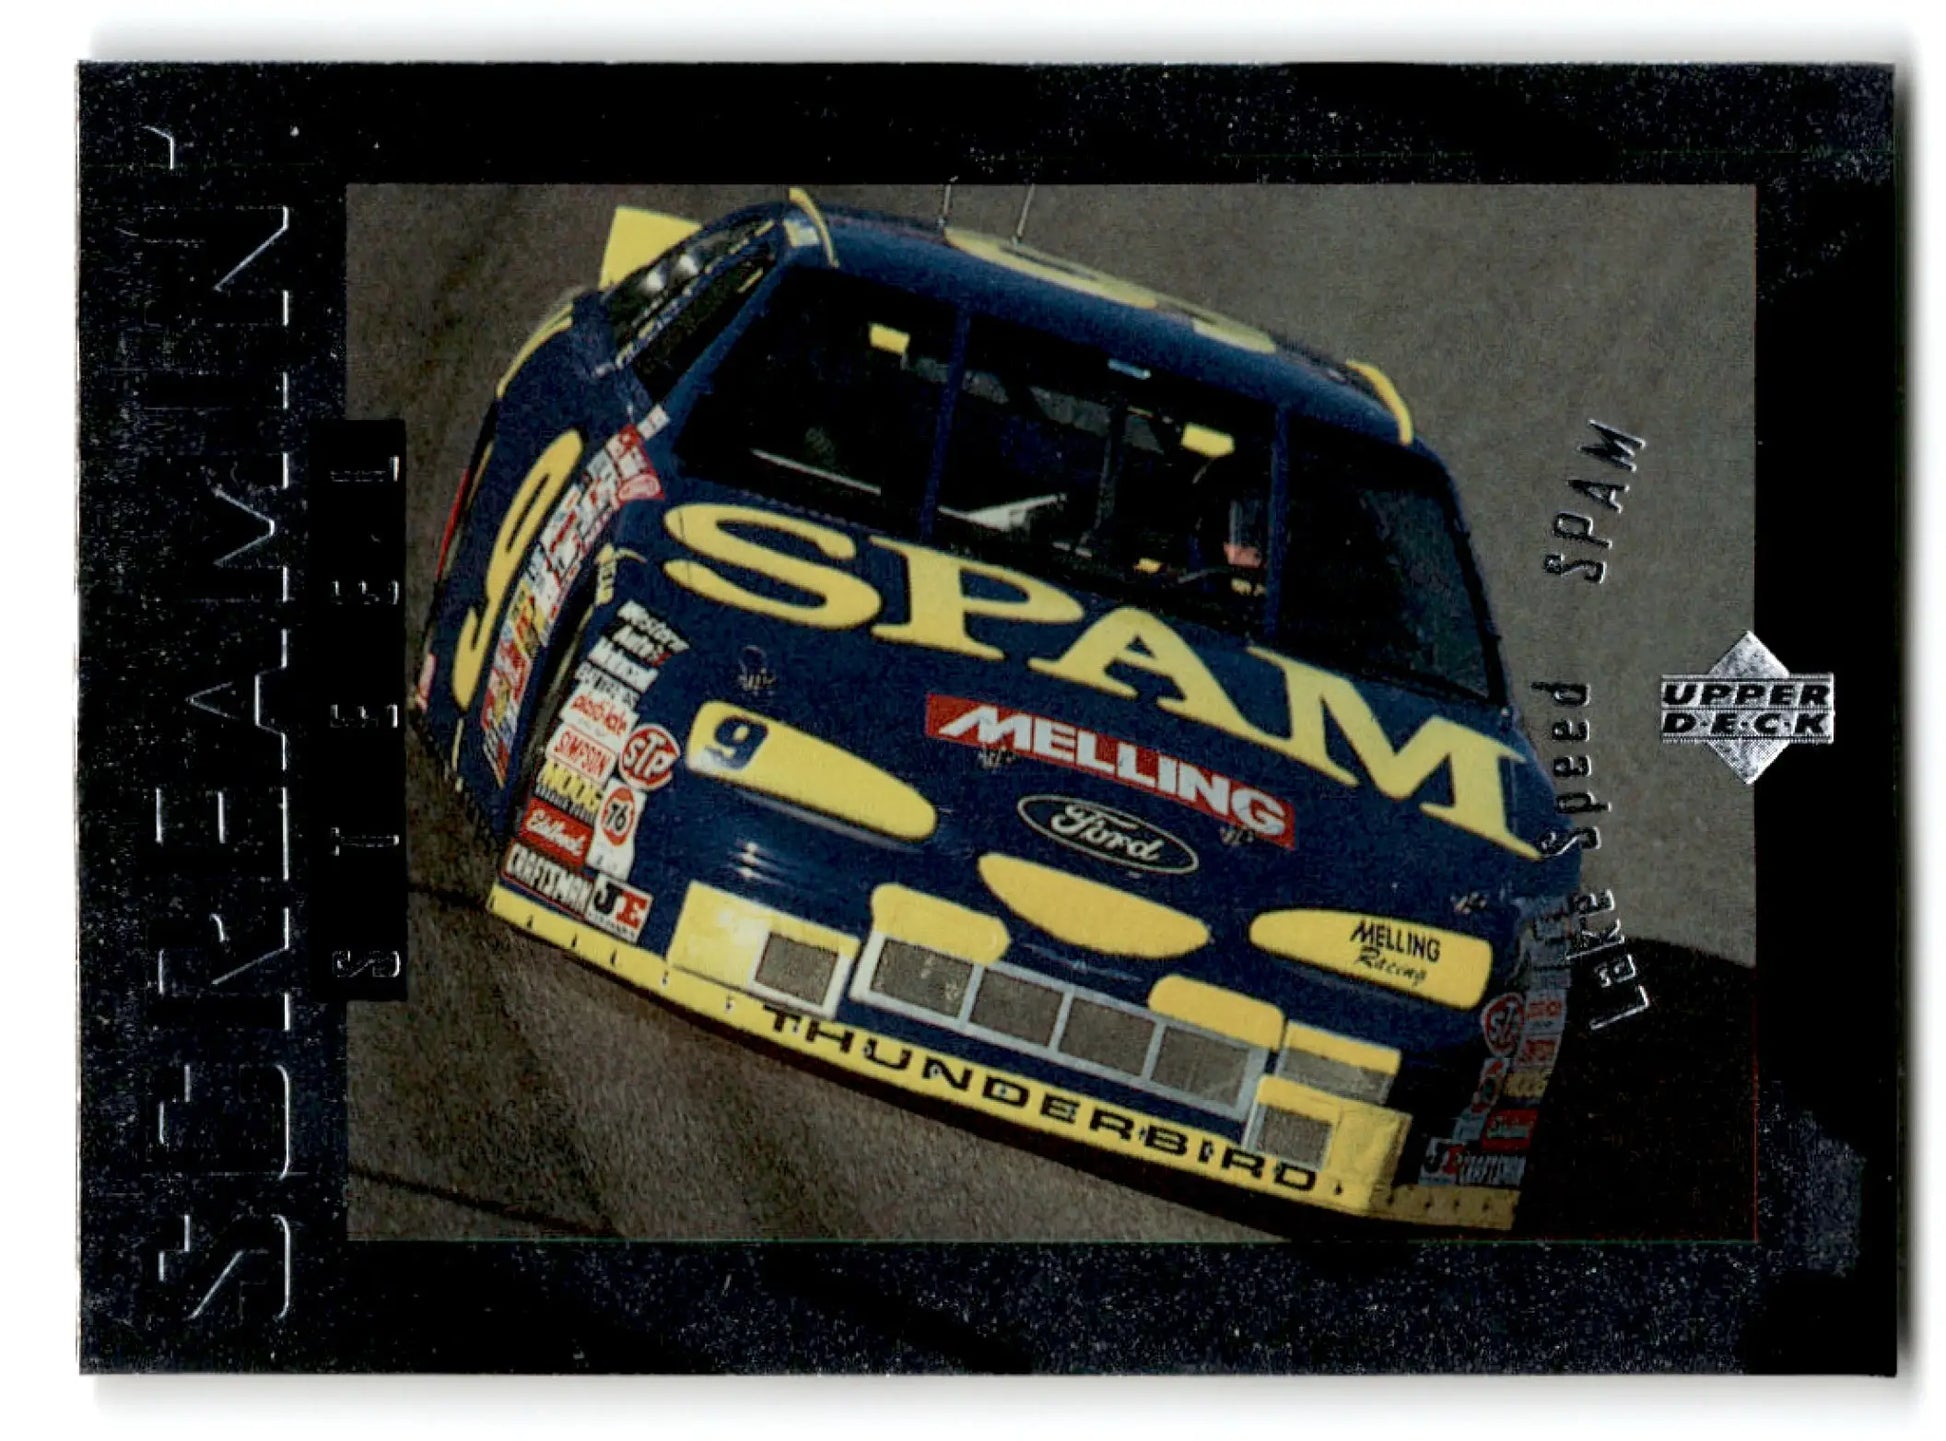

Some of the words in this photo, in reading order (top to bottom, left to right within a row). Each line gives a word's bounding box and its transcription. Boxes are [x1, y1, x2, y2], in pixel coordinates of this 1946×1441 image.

[1543, 419, 1646, 584] SPAM
[663, 503, 1544, 859] SPAM
[1662, 684, 1830, 705] UPPER
[328, 453, 402, 981] STEEL
[703, 717, 769, 771] 9
[554, 731, 610, 778] SIMPSON
[623, 731, 678, 779] STP
[938, 705, 1286, 836] MELLING
[1531, 681, 1612, 860] Speed
[605, 803, 629, 832] 76
[1050, 803, 1165, 863] Ford
[506, 842, 593, 915] CRAFTSMAN
[1349, 919, 1441, 962] MELLING
[1353, 944, 1427, 987] Racing
[1564, 888, 1651, 1030] Lake
[761, 1003, 1317, 1191] THUNDERBIRD
